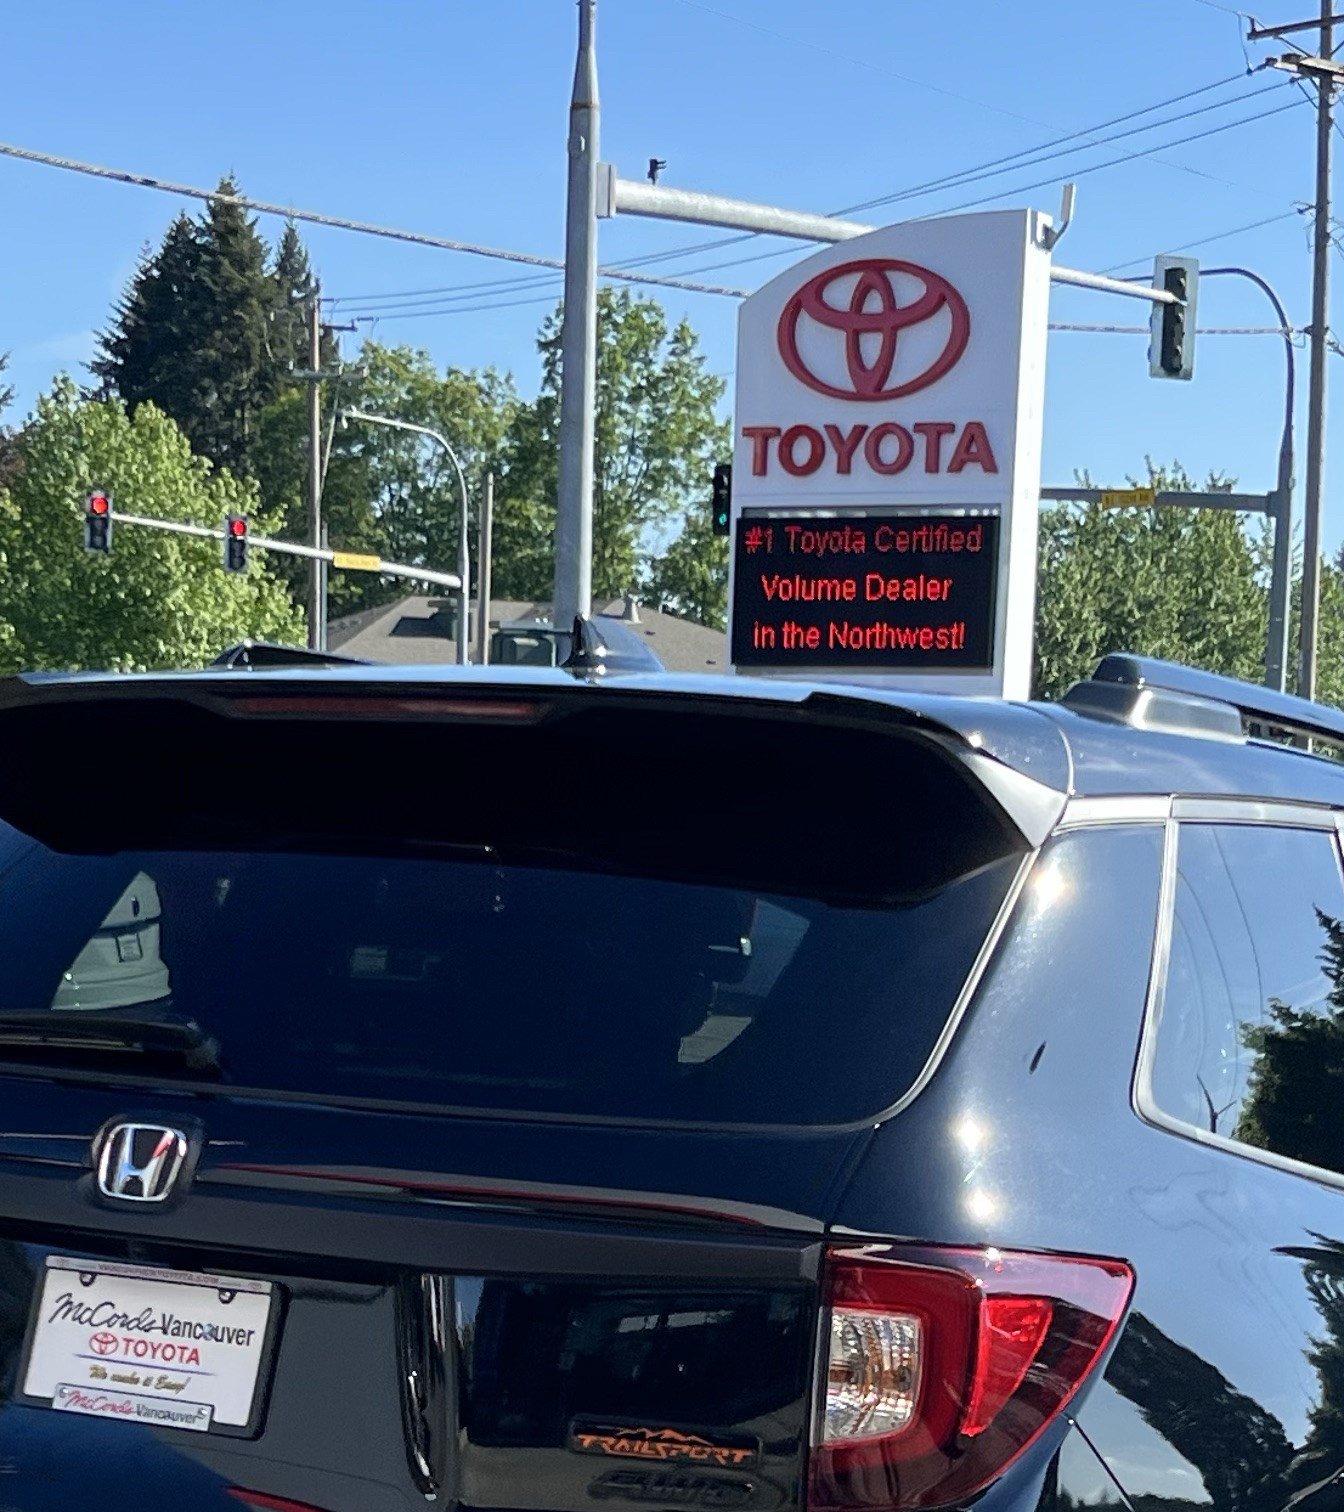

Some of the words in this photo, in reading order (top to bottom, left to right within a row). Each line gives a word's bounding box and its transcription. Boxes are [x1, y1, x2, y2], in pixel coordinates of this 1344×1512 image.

[742, 422, 999, 477] TOYOTA
[745, 525, 773, 554] #1
[784, 525, 867, 558] Toyota
[874, 524, 983, 554] Certified
[761, 573, 857, 602] Volume
[865, 573, 954, 602] Dealer
[782, 620, 821, 650] the
[828, 620, 966, 650] Northwest!
[161, 1313, 256, 1347] Vancouver
[122, 1337, 201, 1366] TOYOTA
[577, 1434, 753, 1465] TRAILSPORT
